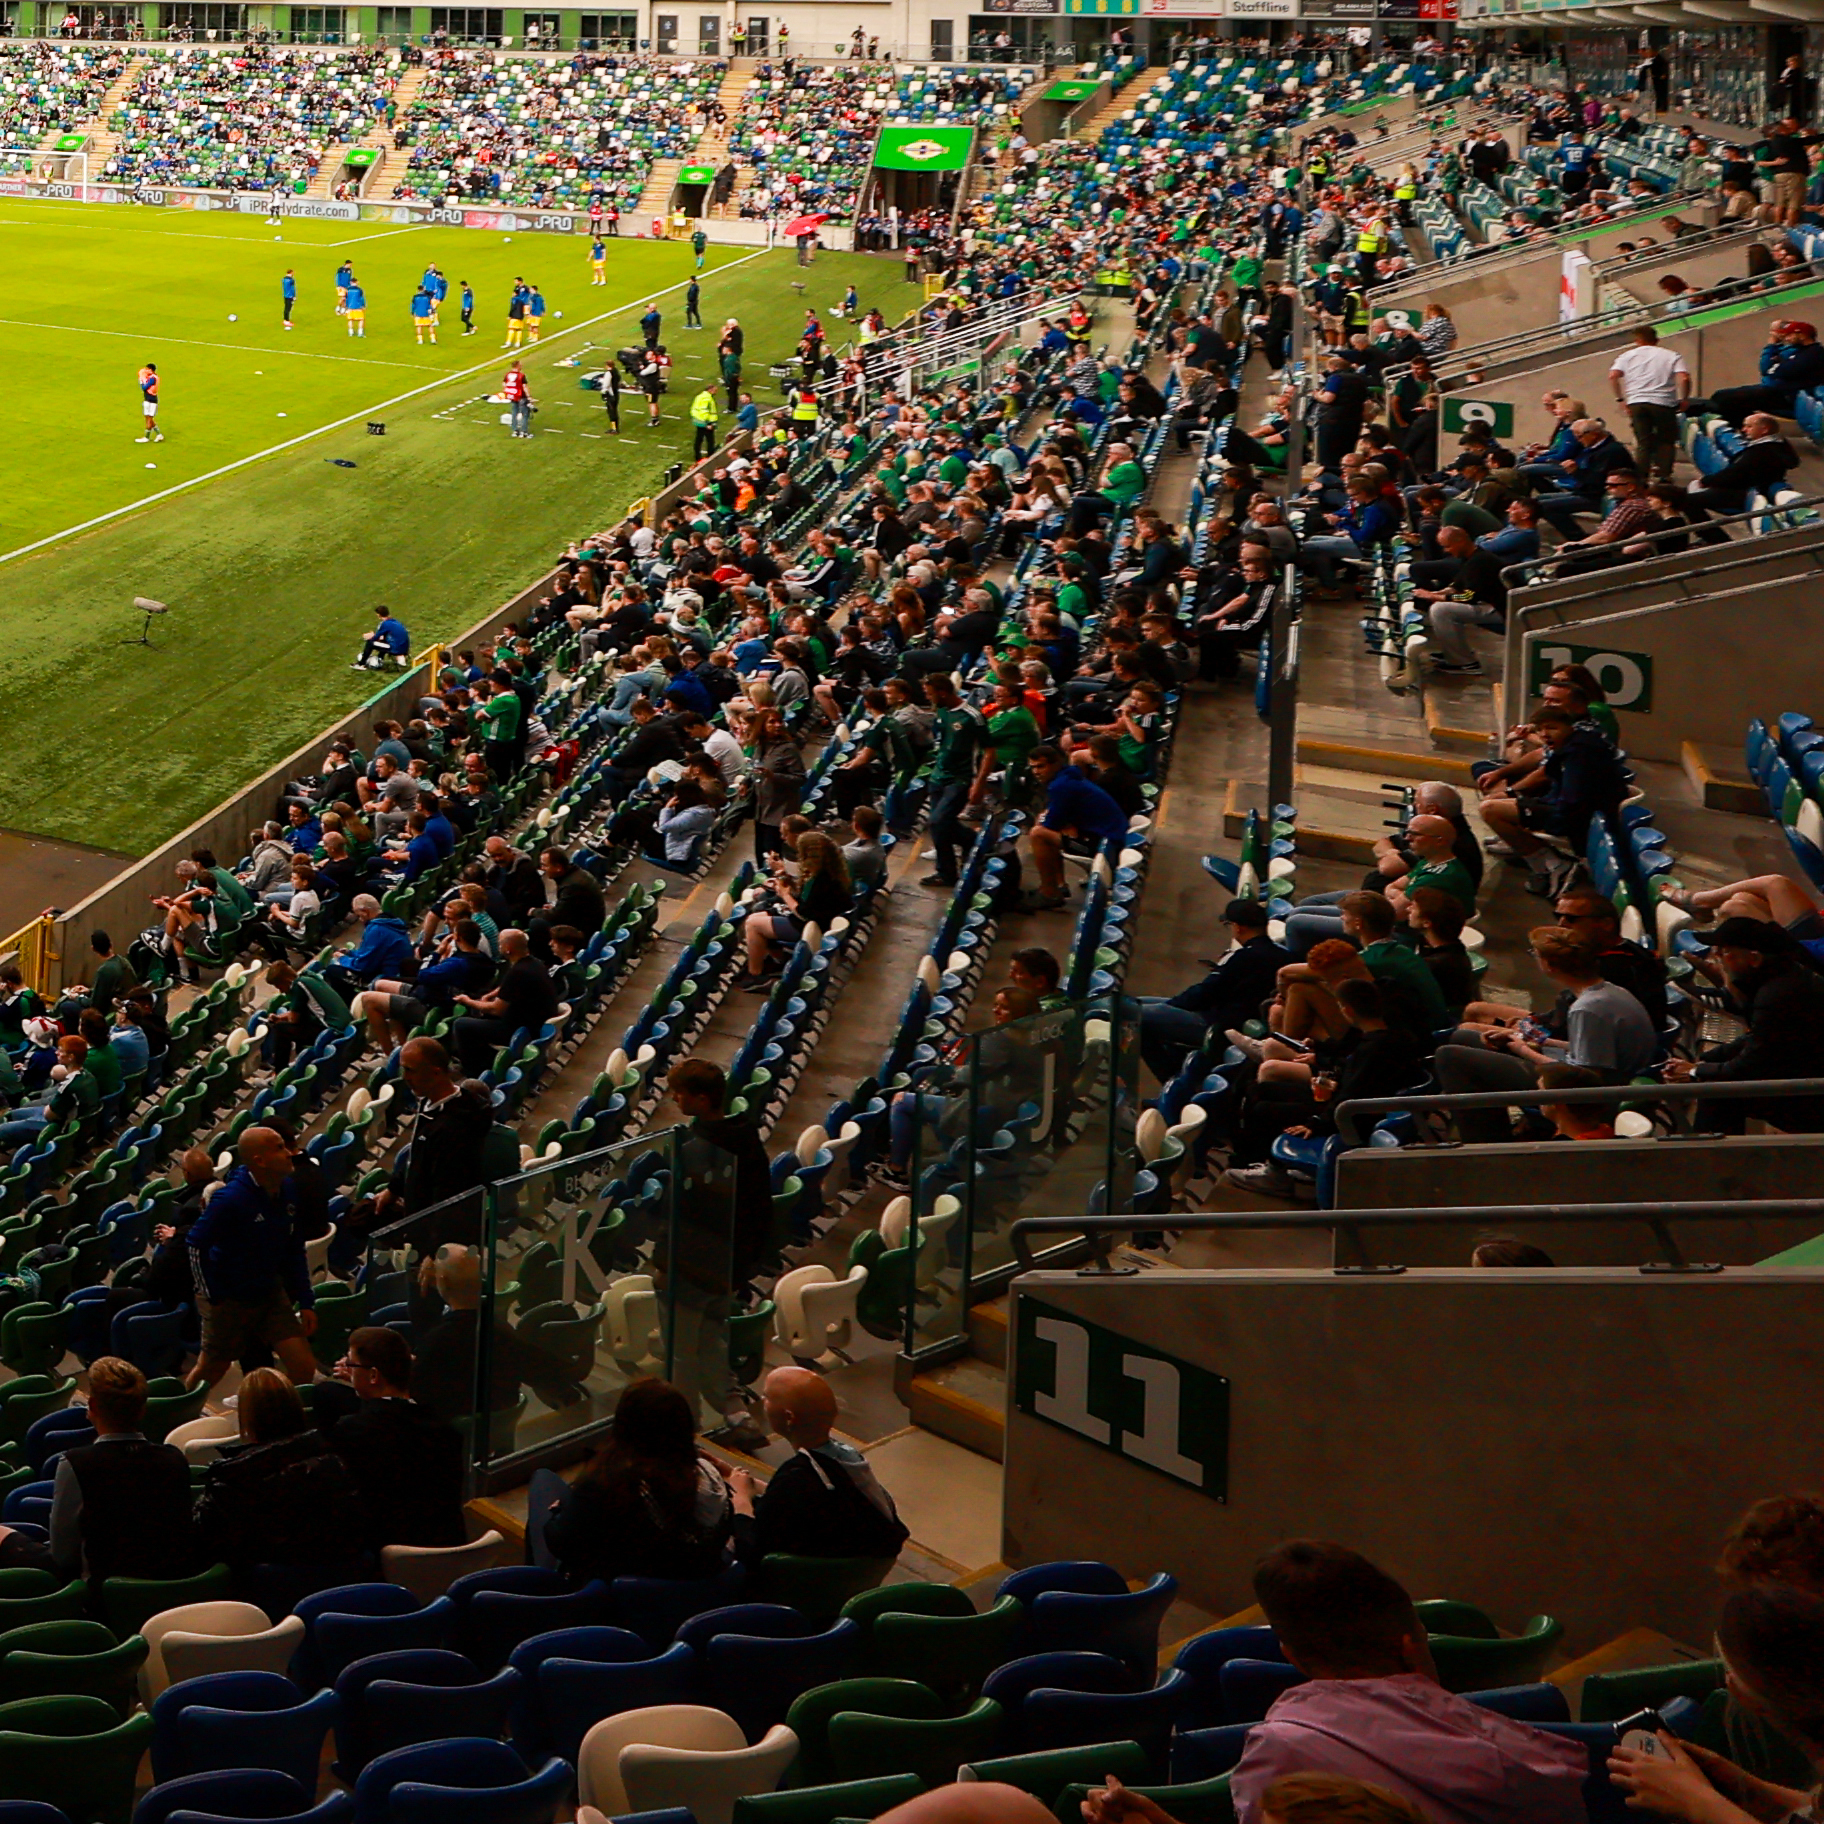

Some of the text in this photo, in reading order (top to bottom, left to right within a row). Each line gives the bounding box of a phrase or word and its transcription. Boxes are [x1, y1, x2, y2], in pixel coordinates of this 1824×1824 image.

[1233, 1, 1290, 13] Staffline
[250, 200, 348, 218] iPRHydrate.com
[1540, 648, 1644, 706] 10
[1030, 1052, 1056, 1143] J
[562, 1196, 614, 1305] K
[1034, 1315, 1203, 1487] 11
